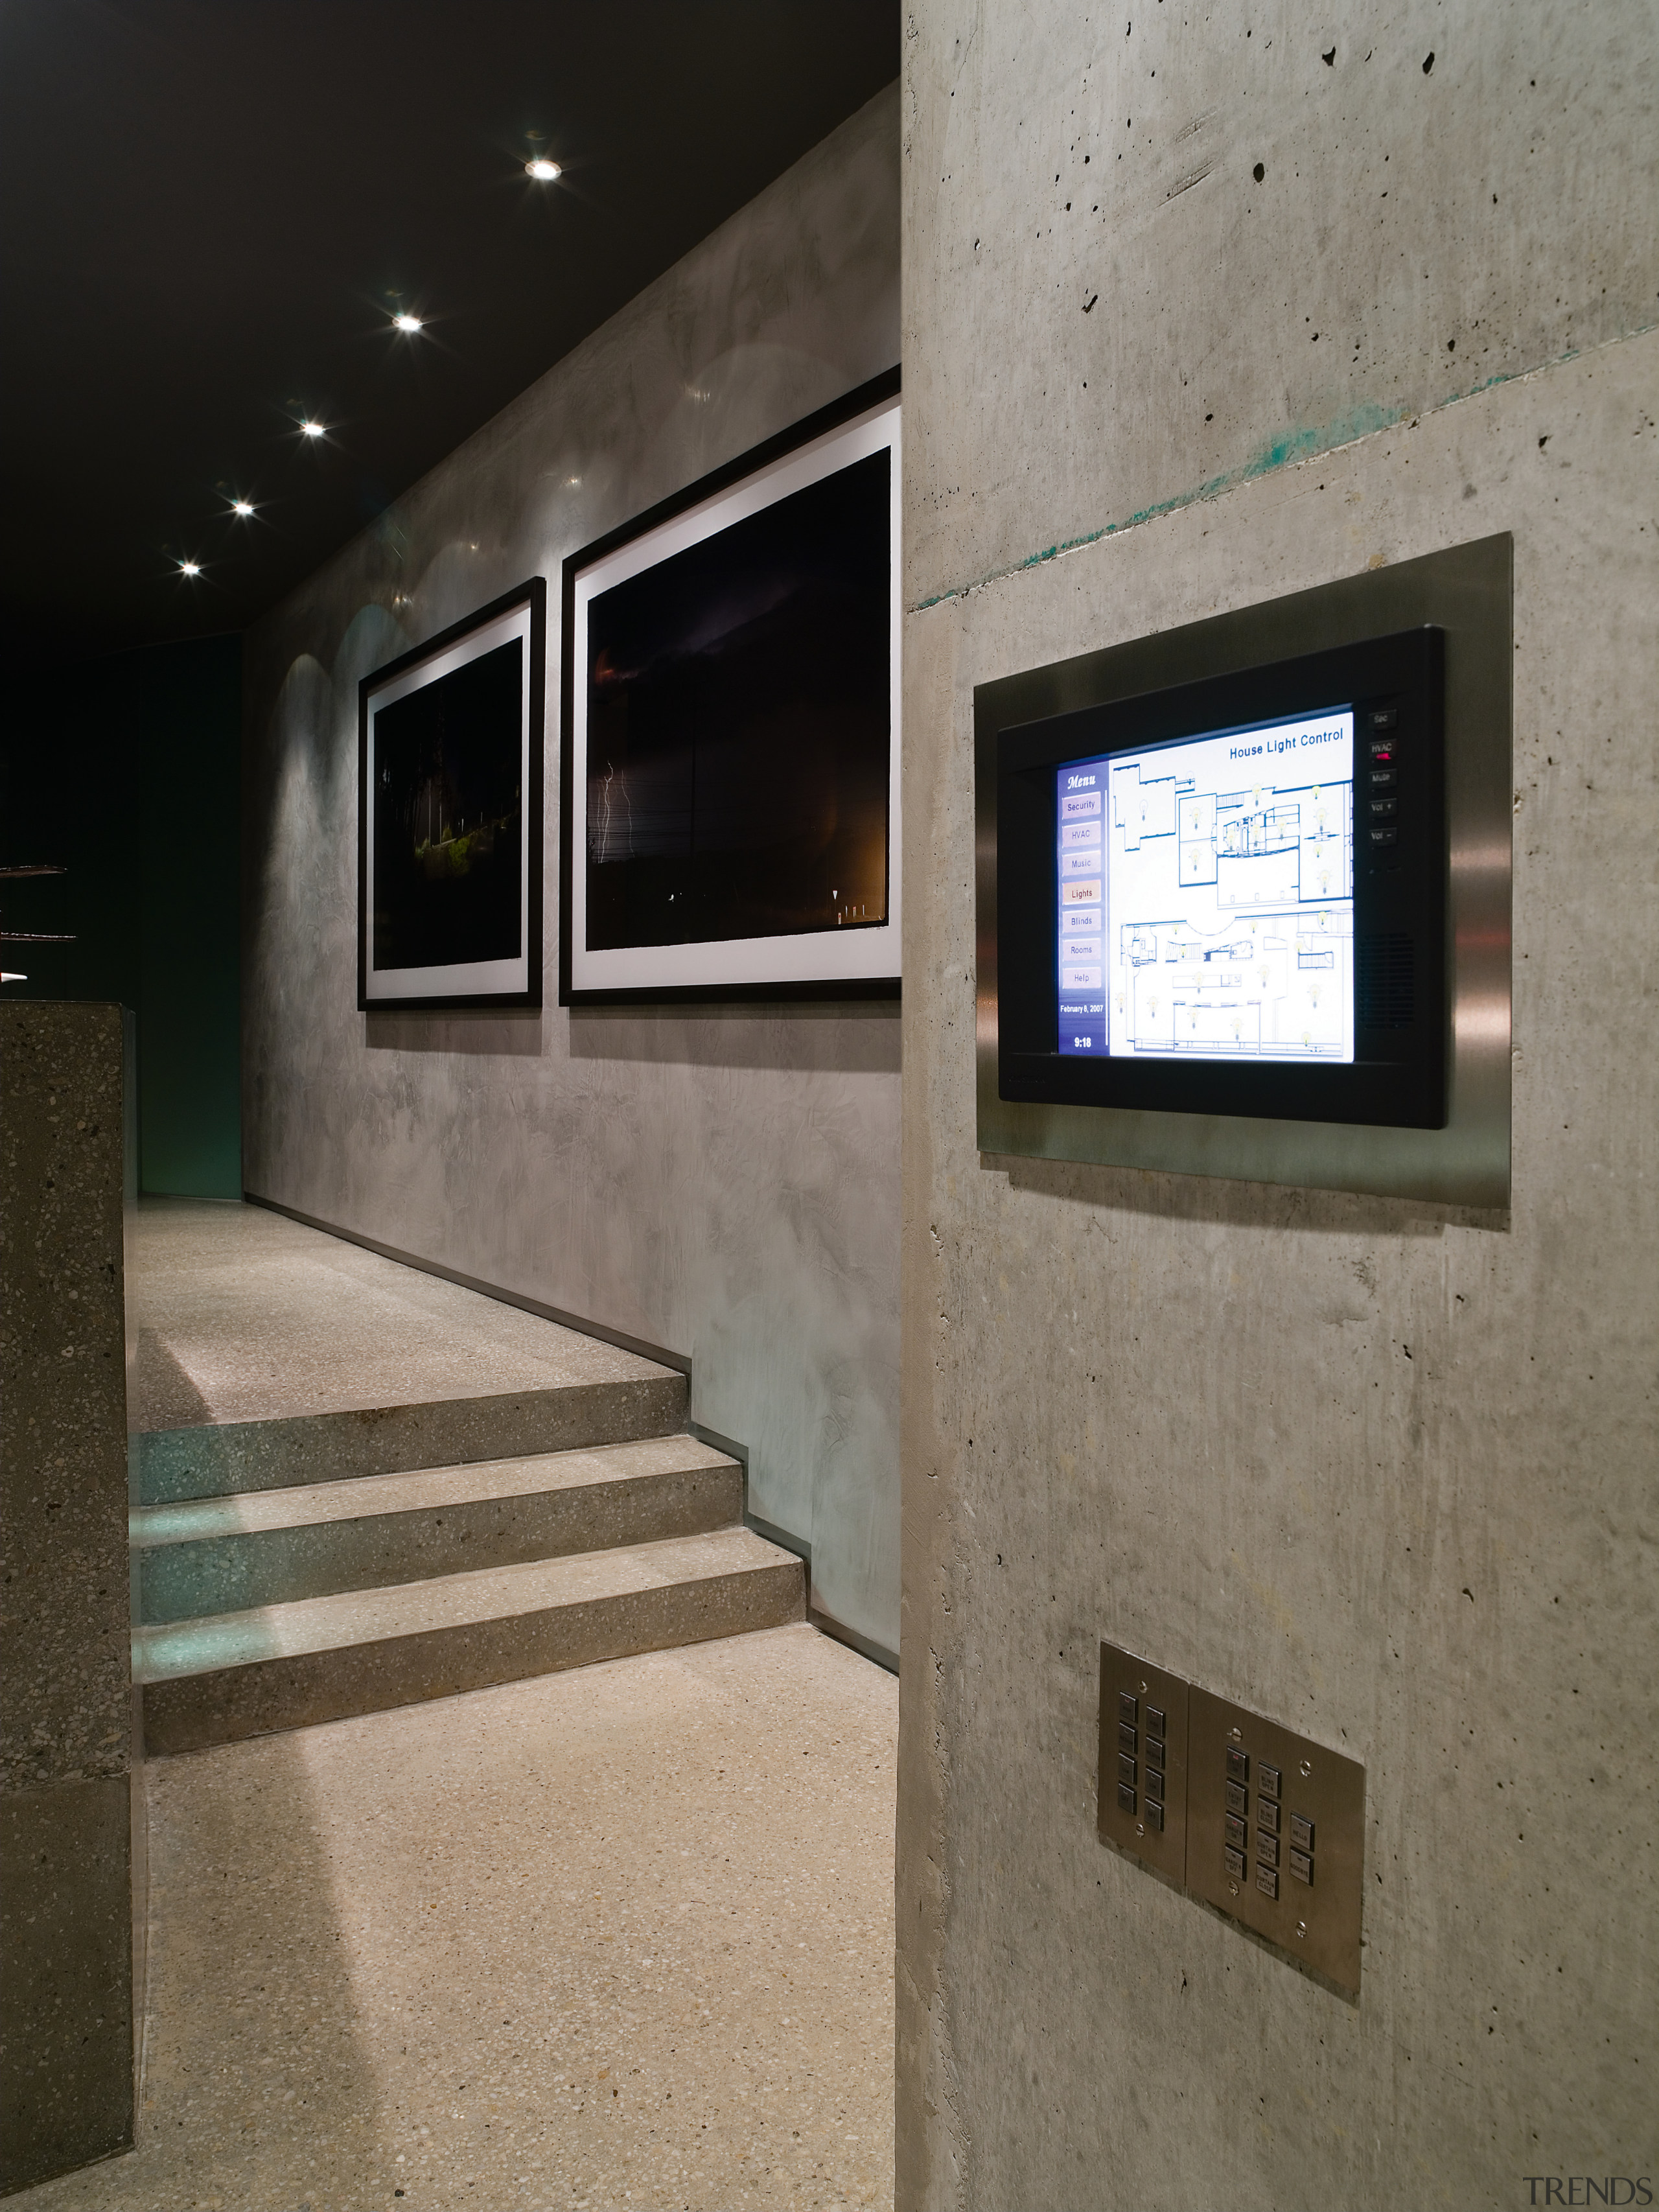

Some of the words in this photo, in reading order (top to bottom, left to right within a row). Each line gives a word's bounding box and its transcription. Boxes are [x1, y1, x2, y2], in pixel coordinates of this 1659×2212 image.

[1374, 715, 1388, 723] Sec
[1230, 745, 1263, 760] House
[1267, 737, 1296, 753] Light
[1301, 727, 1343, 746] Control
[1372, 743, 1392, 753] HVAC
[1067, 774, 1096, 789] Menu
[1372, 773, 1391, 782] Mute
[1067, 800, 1095, 811] Security
[1371, 803, 1383, 811] Vol
[1072, 830, 1090, 839] HVAC
[1371, 832, 1383, 840] Vol
[1072, 859, 1091, 868] Music
[1072, 890, 1093, 899] Lights
[1071, 917, 1092, 926] Blinds
[1060, 1005, 1083, 1014] February
[1084, 1005, 1089, 1014] 8,
[1074, 1036, 1091, 1048] 9:18
[1261, 1775, 1274, 1786] BLIND
[1262, 1782, 1273, 1791] OPEN
[1260, 1809, 1273, 1820] BLIND
[1260, 1815, 1273, 1826] CLOSE
[1292, 1829, 1307, 1841] HELLO
[1260, 1848, 1272, 1858] OPEN
[1290, 1863, 1308, 1877] GOODBYE
[1257, 1875, 1275, 1888] CURTAIN
[1259, 1881, 1272, 1893] CLOSE
